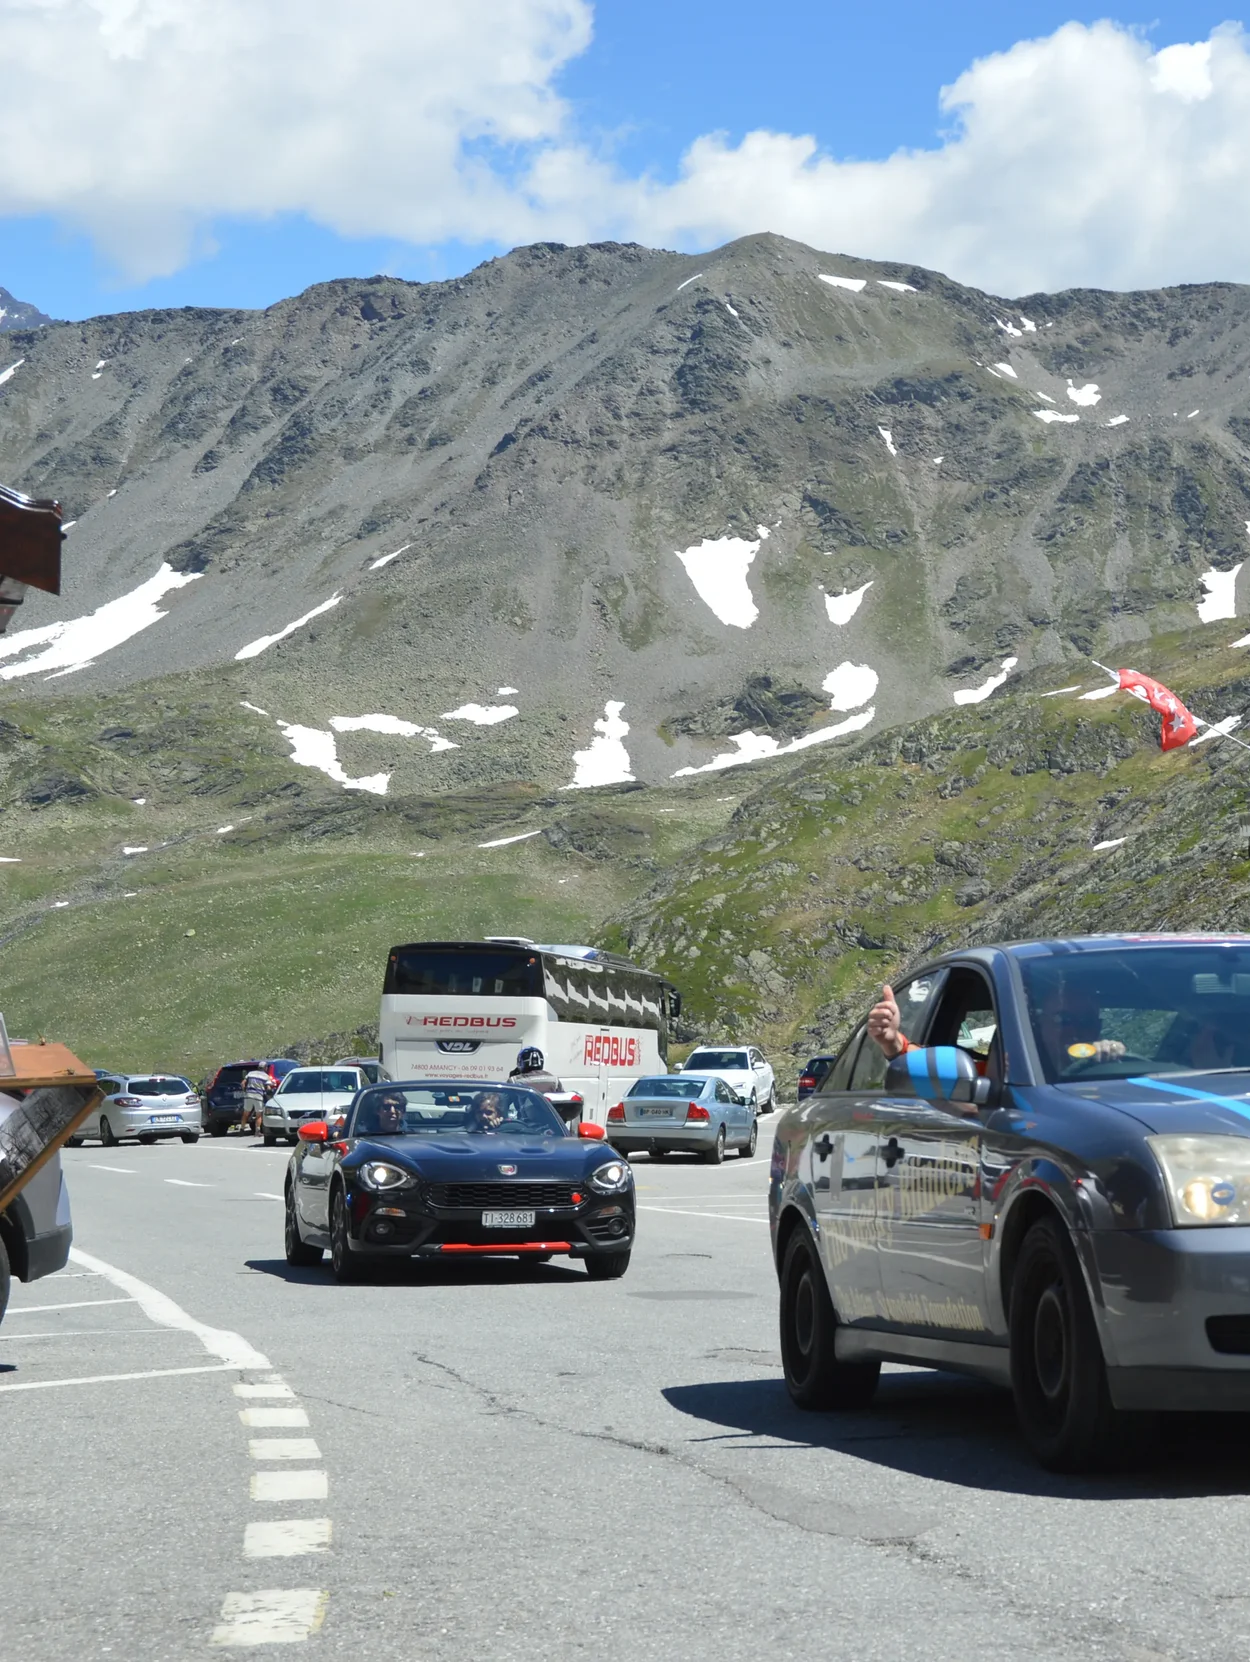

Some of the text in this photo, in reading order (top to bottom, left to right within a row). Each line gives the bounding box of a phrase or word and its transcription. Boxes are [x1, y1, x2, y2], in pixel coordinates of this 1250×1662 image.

[422, 1015, 517, 1028] REDBUS
[441, 1041, 474, 1052] VDL
[583, 1034, 636, 1067] REDBUS
